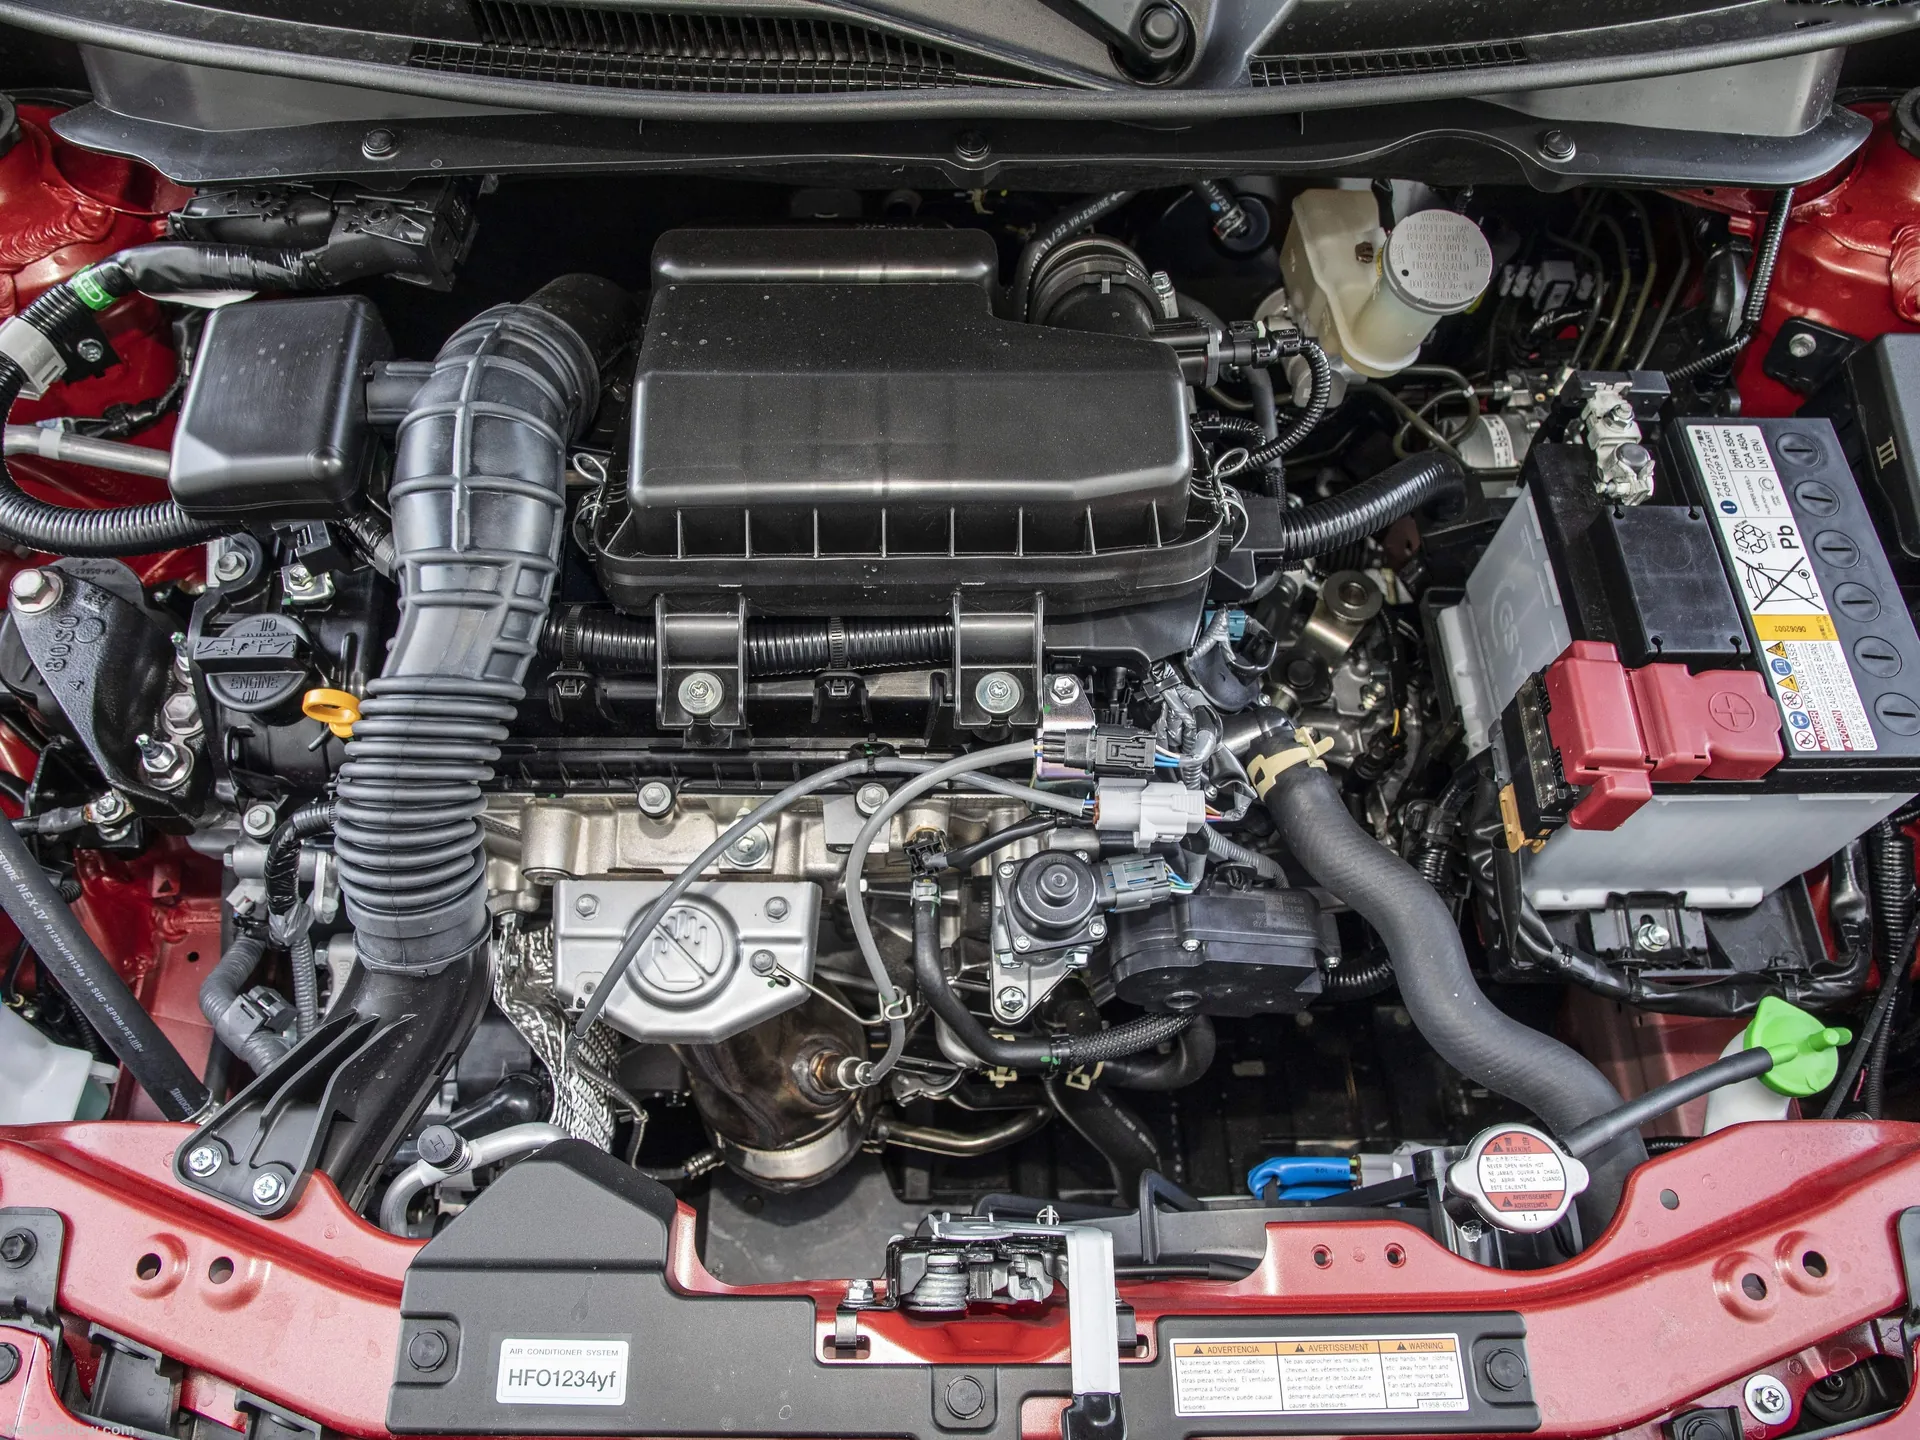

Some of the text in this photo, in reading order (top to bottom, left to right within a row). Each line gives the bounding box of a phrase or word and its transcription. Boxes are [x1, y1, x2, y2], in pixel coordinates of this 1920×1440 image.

[1041, 224, 1067, 250] 11/32
[1702, 430, 1716, 452] START
[1720, 429, 1743, 468] 20HR 55Ah
[1735, 433, 1756, 468] CCA 450A
[1749, 438, 1768, 468] LN1 (EN)
[1713, 461, 1726, 479] STOP
[1721, 481, 1732, 496] FOR
[1777, 525, 1800, 550] Pb
[1785, 642, 1801, 667] GASES
[1808, 643, 1822, 661] BURNS
[230, 675, 280, 689] ENGINE
[1814, 662, 1830, 684] SEVERE
[1844, 677, 1854, 688] AND
[240, 690, 261, 703] OIL
[1796, 670, 1816, 710] EXPLOSIVE
[1822, 686, 1839, 708] CAUSES
[1808, 711, 1826, 740] DANGER
[1832, 711, 1850, 739] POISON
[1859, 720, 1870, 732] VENT
[84, 978, 94, 986] 15
[91, 988, 106, 1003] SUC
[1308, 1344, 1369, 1352] AVERTISSEMENT
[508, 1368, 616, 1392] HFO1234yf
